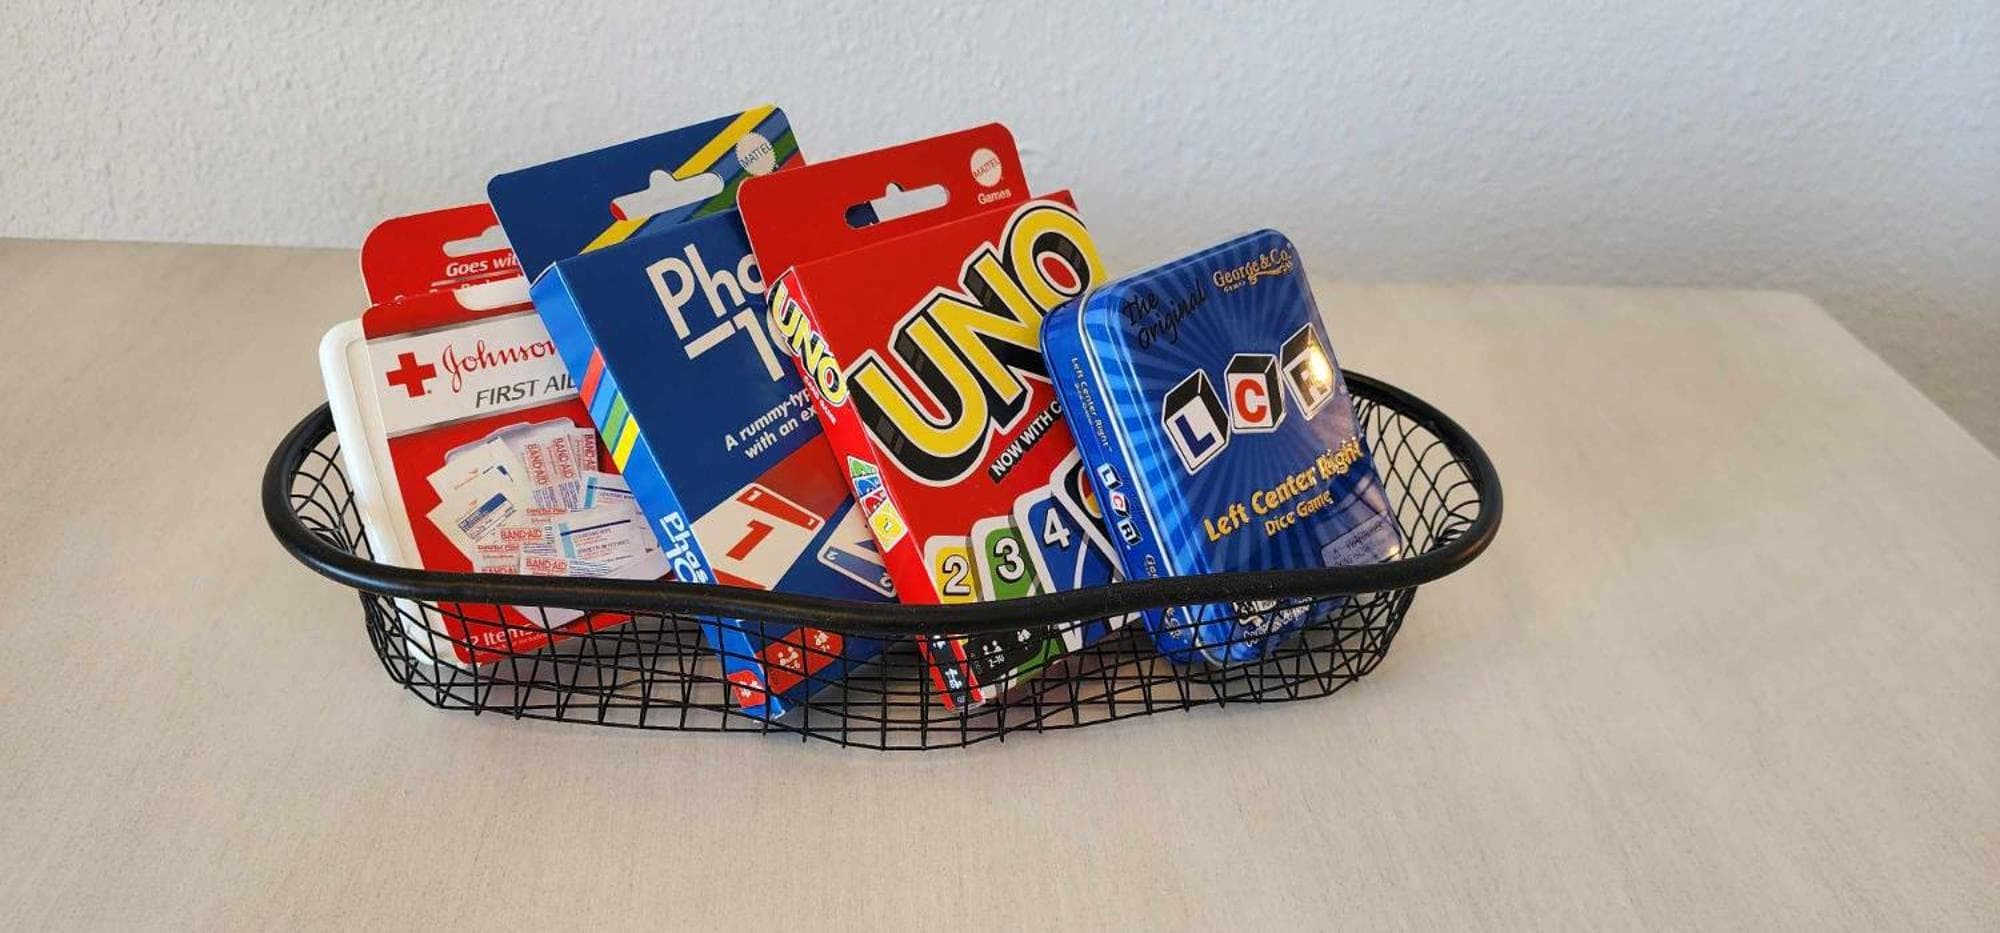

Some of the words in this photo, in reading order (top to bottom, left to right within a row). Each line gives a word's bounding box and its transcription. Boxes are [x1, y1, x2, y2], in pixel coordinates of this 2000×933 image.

[740, 142, 774, 169] MATTEL
[972, 157, 1002, 179] MATTEL
[977, 189, 1012, 205] Games
[446, 259, 489, 277] Goes
[1122, 292, 1158, 325] The
[767, 278, 850, 407] UNO
[843, 201, 1108, 486] UNO
[475, 379, 540, 408] FIRST
[1071, 357, 1084, 379] Left
[1080, 381, 1097, 416] Center
[724, 434, 739, 451] A
[744, 432, 778, 459] with
[779, 419, 799, 436] an
[990, 442, 1024, 477] NOW
[1019, 411, 1052, 445] WITH
[1203, 502, 1251, 542] Left
[1251, 468, 1319, 515] Center
[1315, 438, 1364, 481] Right
[1042, 506, 1071, 549] 4
[1264, 511, 1296, 537] Dice
[1296, 490, 1334, 518] Game
[726, 519, 776, 561] 1
[994, 536, 1025, 583] 3
[943, 554, 971, 596] 2
